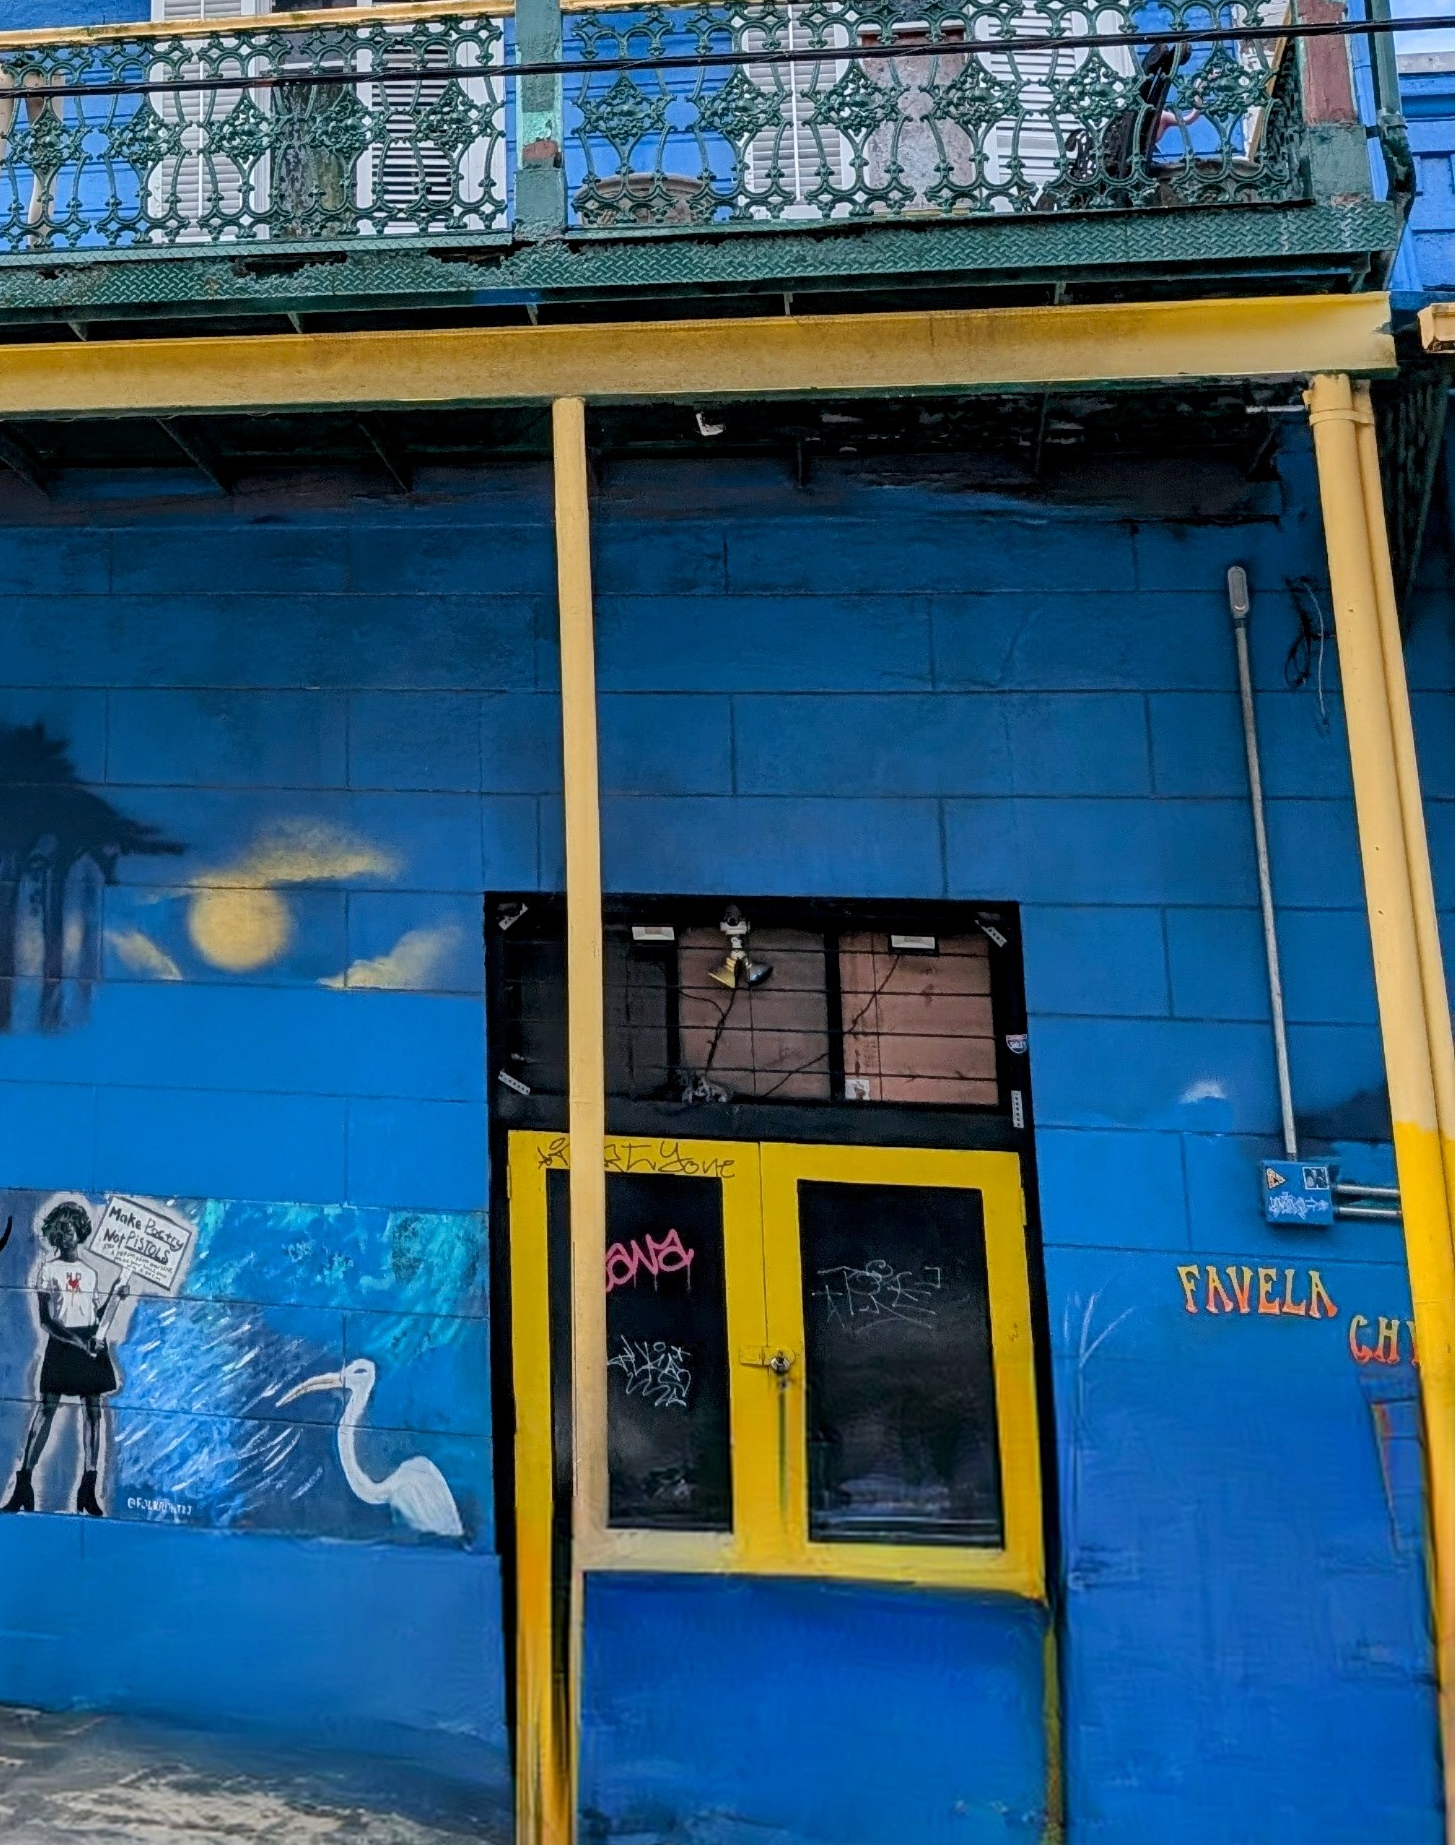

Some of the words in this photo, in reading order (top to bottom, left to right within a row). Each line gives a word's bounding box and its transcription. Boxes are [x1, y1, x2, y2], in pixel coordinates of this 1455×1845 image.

[109, 1206, 142, 1231] Make
[103, 1228, 126, 1250] Not
[1177, 1264, 1338, 1318] FAVELA
